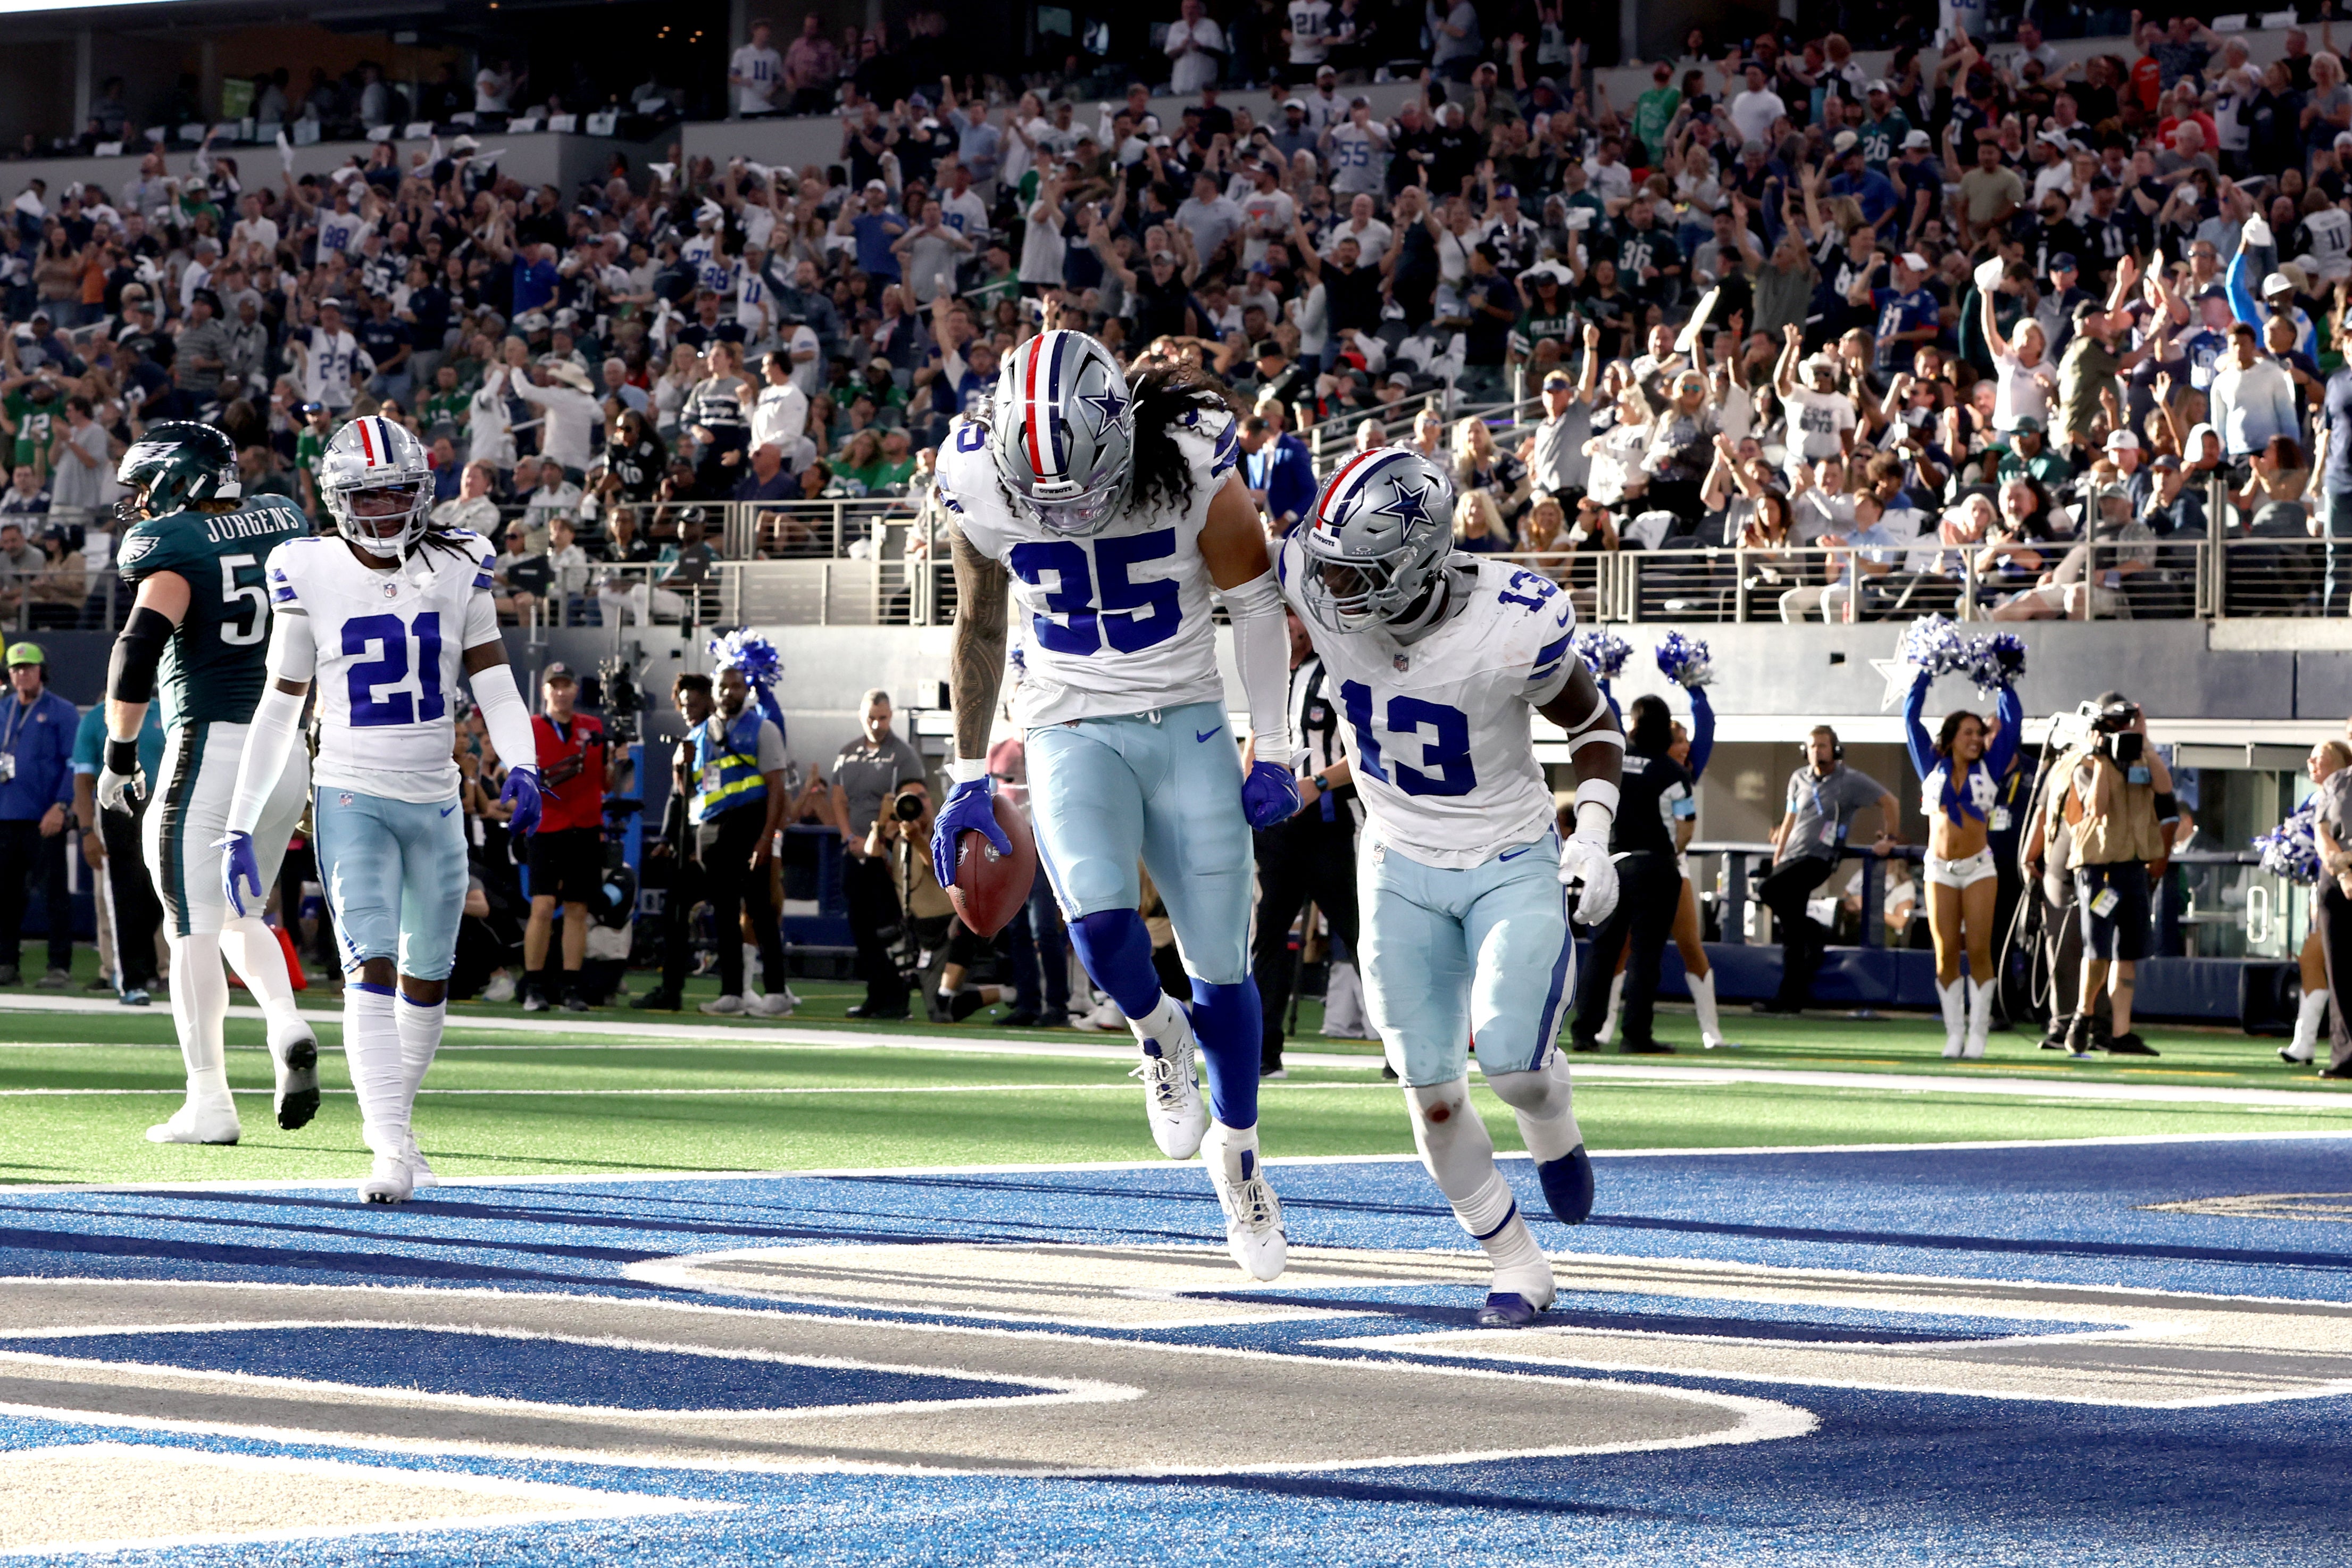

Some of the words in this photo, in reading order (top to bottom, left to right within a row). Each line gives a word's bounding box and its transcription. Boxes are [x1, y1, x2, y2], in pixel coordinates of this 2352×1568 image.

[754, 60, 766, 80] 11
[1340, 140, 1369, 166] 55
[1863, 134, 1890, 162] 26
[322, 224, 348, 249] 88
[1619, 240, 1653, 272] 36
[205, 507, 299, 543] JURGENS
[1313, 532, 1335, 547] COWBOYS
[1010, 527, 1183, 656] 35
[1498, 570, 1558, 613] 13
[341, 612, 445, 727] 21
[1340, 679, 1478, 797] 13
